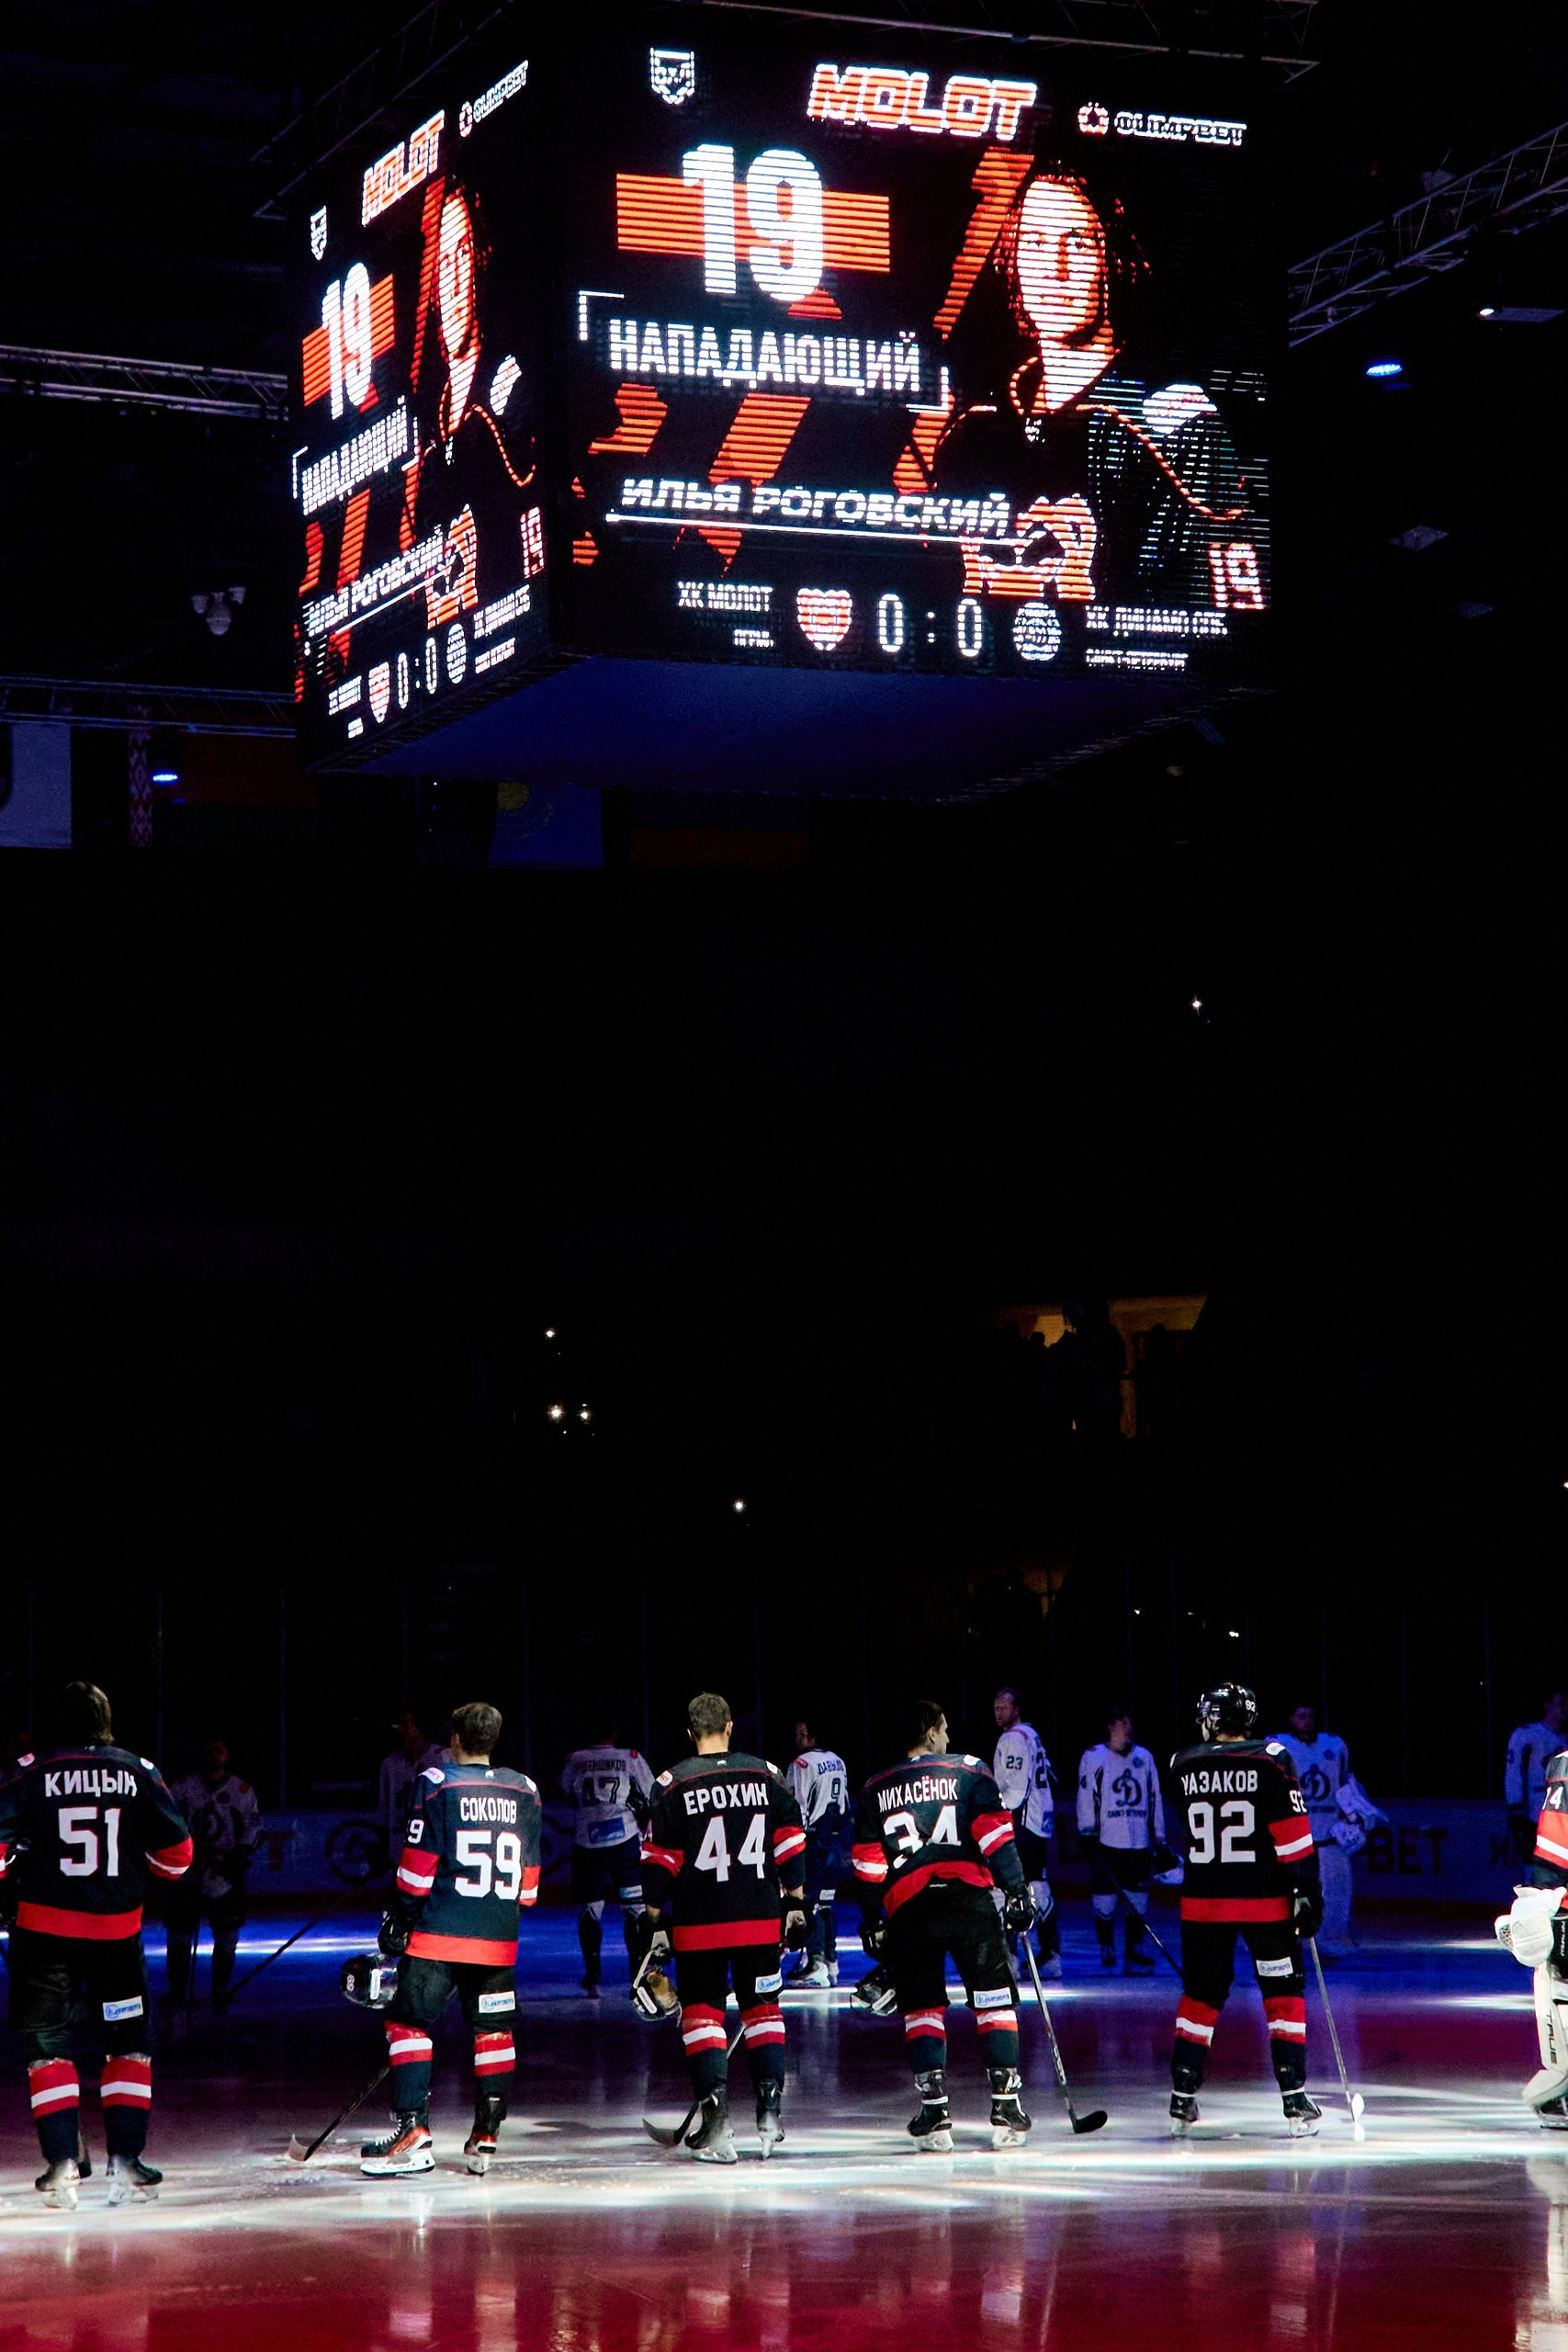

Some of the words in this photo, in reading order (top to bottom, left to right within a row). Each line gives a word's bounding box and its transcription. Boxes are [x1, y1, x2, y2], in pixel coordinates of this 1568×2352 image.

[807, 63, 1037, 140] MOLOT
[1114, 111, 1247, 146] OLIMPBET
[362, 109, 445, 227] MOLOT
[682, 143, 823, 301] 19
[321, 262, 371, 420] 19
[609, 318, 919, 396] НАПАДАЮЩИЙ
[621, 478, 741, 512] ИЛЬЯ
[751, 484, 1011, 537] РОГОВСКИЙ
[520, 506, 544, 579] 19
[677, 581, 705, 608] ХК
[707, 582, 773, 612] МОЛОТ
[1208, 543, 1265, 610] 19
[878, 593, 903, 653] 0
[957, 598, 982, 657] 0
[44, 1769, 138, 1798] КИЦЫН
[581, 1776, 620, 1806] 47
[877, 1774, 958, 1814] МИХАСЁНОК
[1006, 1756, 1023, 1770] 23
[459, 1796, 517, 1825] СОКОЛОВ
[682, 1782, 770, 1815] ЕРОХИН
[1289, 1790, 1307, 1813] 92
[58, 1806, 121, 1877] 51
[407, 1818, 424, 1844] 9
[694, 1813, 766, 1883] 44
[883, 1804, 962, 1870] 34
[1187, 1800, 1257, 1864] 92
[454, 1829, 522, 1901] 59
[1546, 2008, 1559, 2064] TRUE
